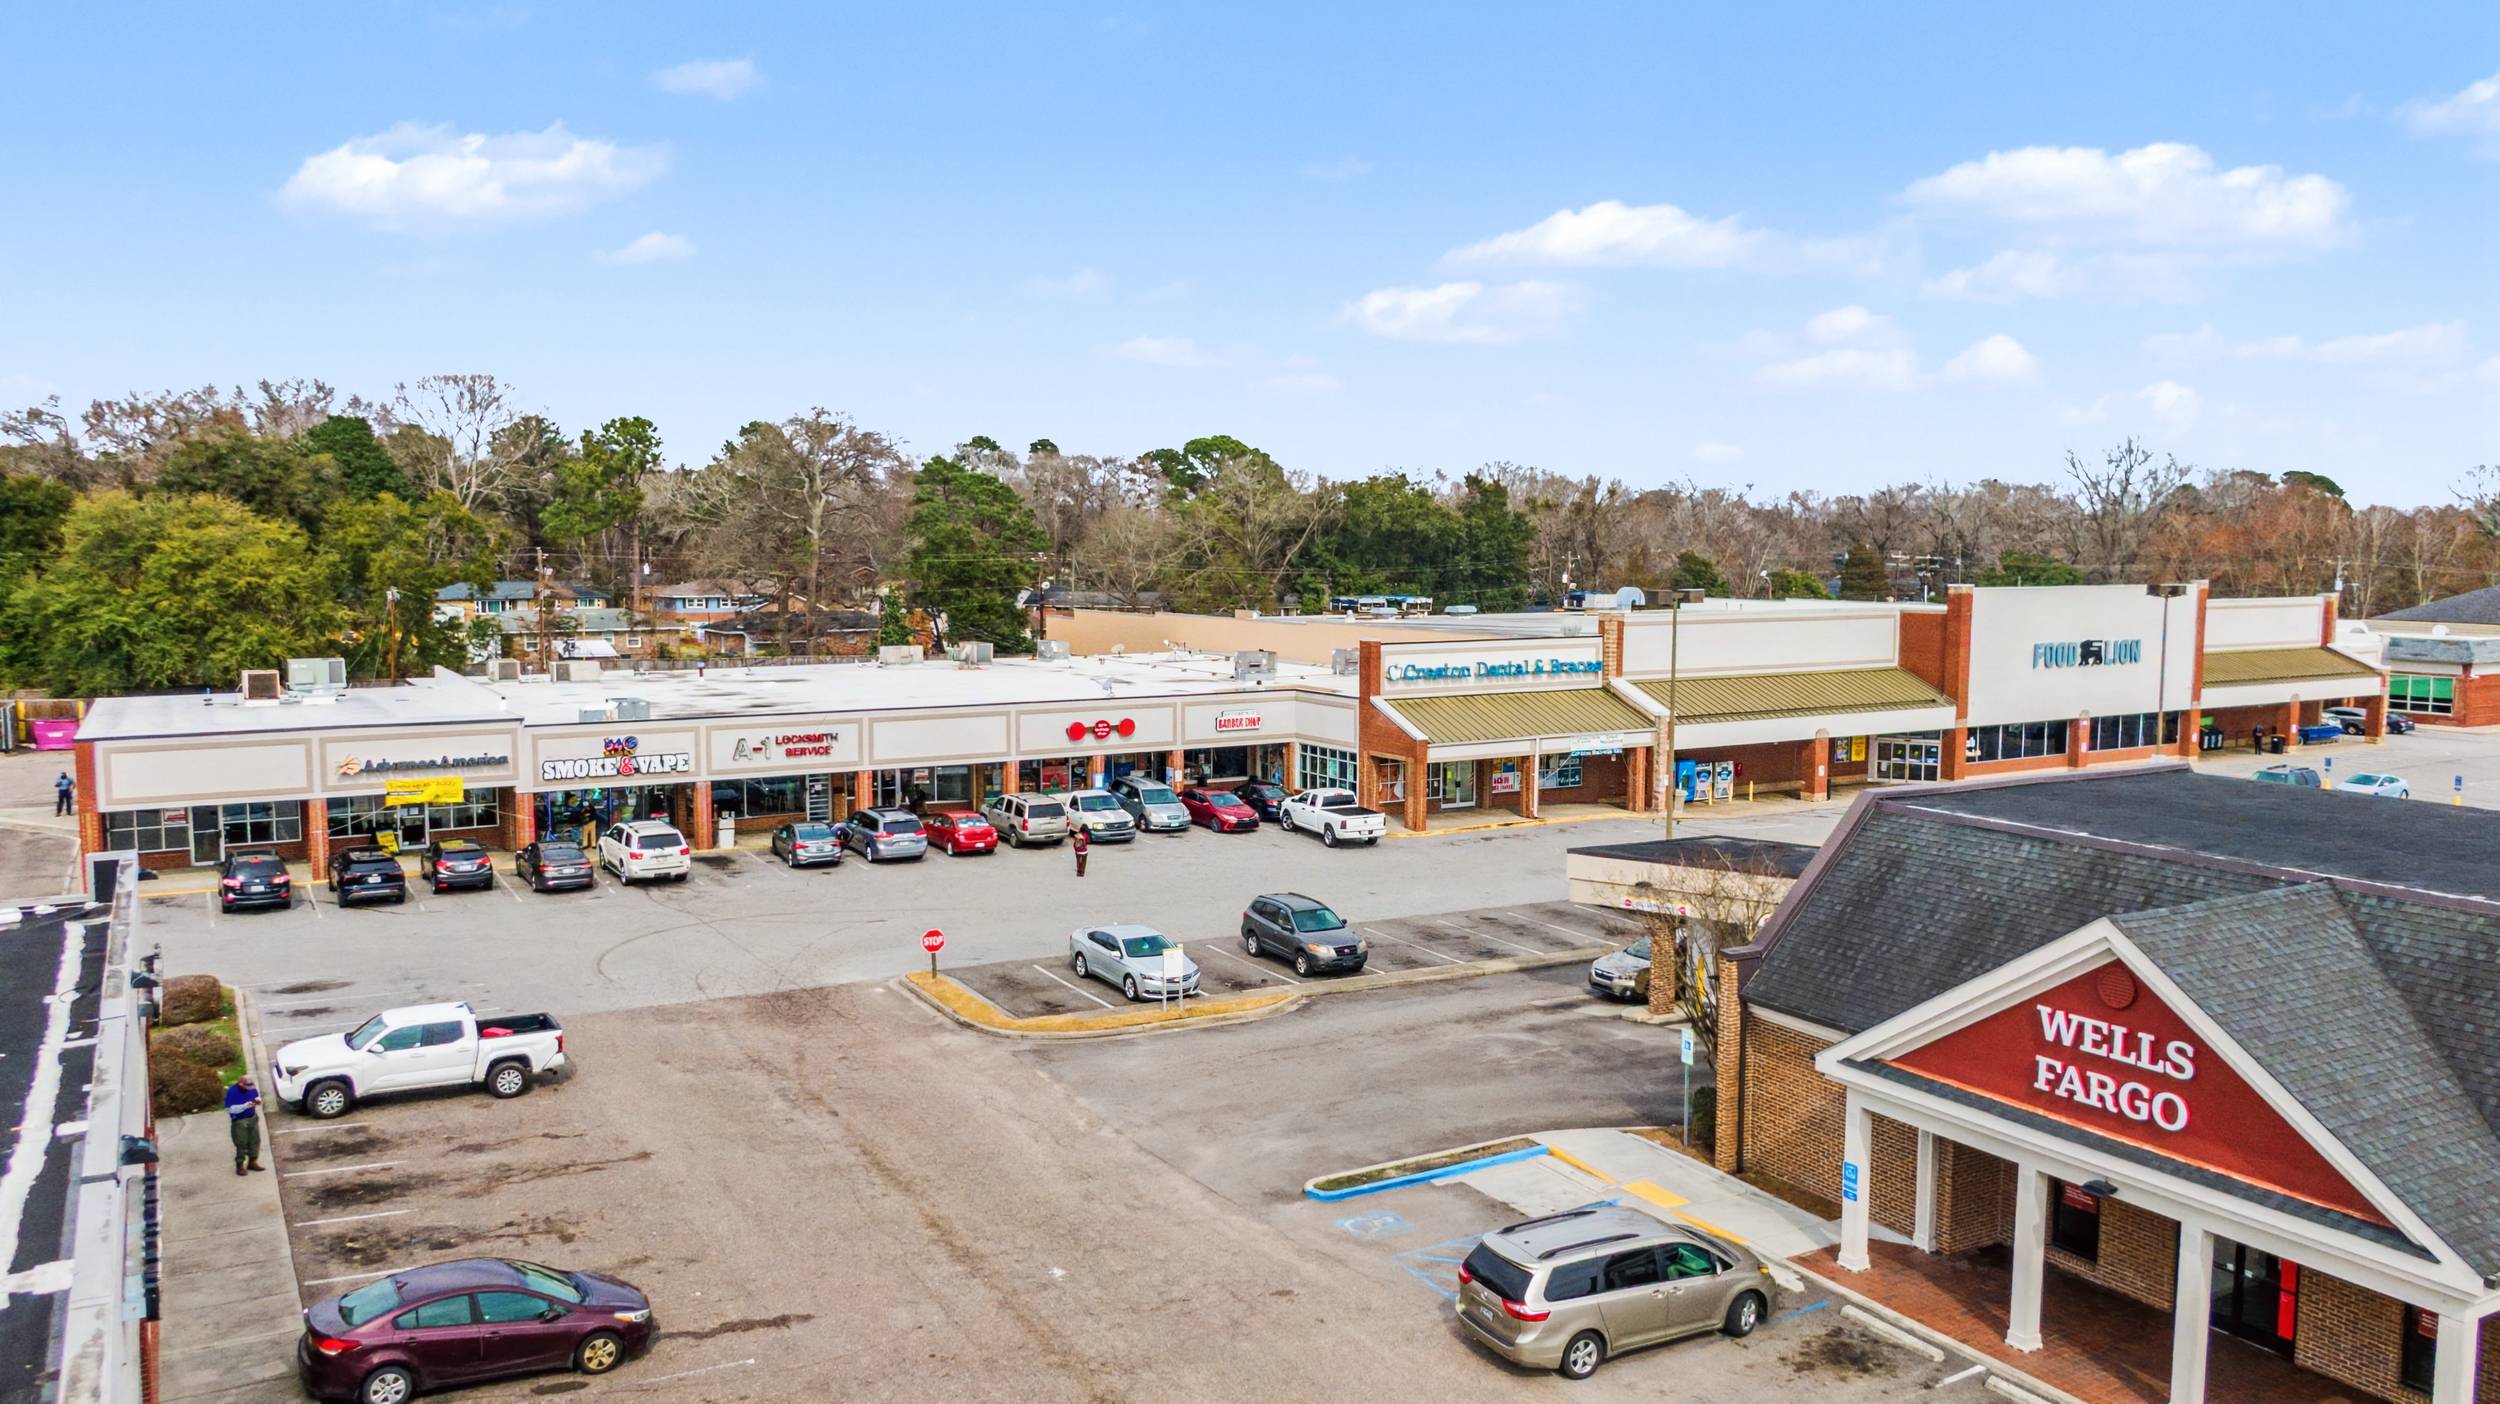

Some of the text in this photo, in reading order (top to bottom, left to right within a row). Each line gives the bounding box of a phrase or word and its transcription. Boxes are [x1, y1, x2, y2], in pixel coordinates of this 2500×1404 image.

[2032, 639, 2142, 669] FOOD LION
[1476, 659, 1530, 677] Dental
[1534, 658, 1545, 675] &
[1550, 657, 1603, 674] Braces
[775, 732, 839, 746] LOCKSMITH
[784, 745, 833, 758] SERVICE
[363, 752, 509, 773] Advance America
[542, 752, 690, 780] SMOKE & VAPE
[923, 935, 944, 947] STOP
[2036, 1003, 2196, 1081] WELLS
[2033, 1054, 2191, 1132] FARGO
